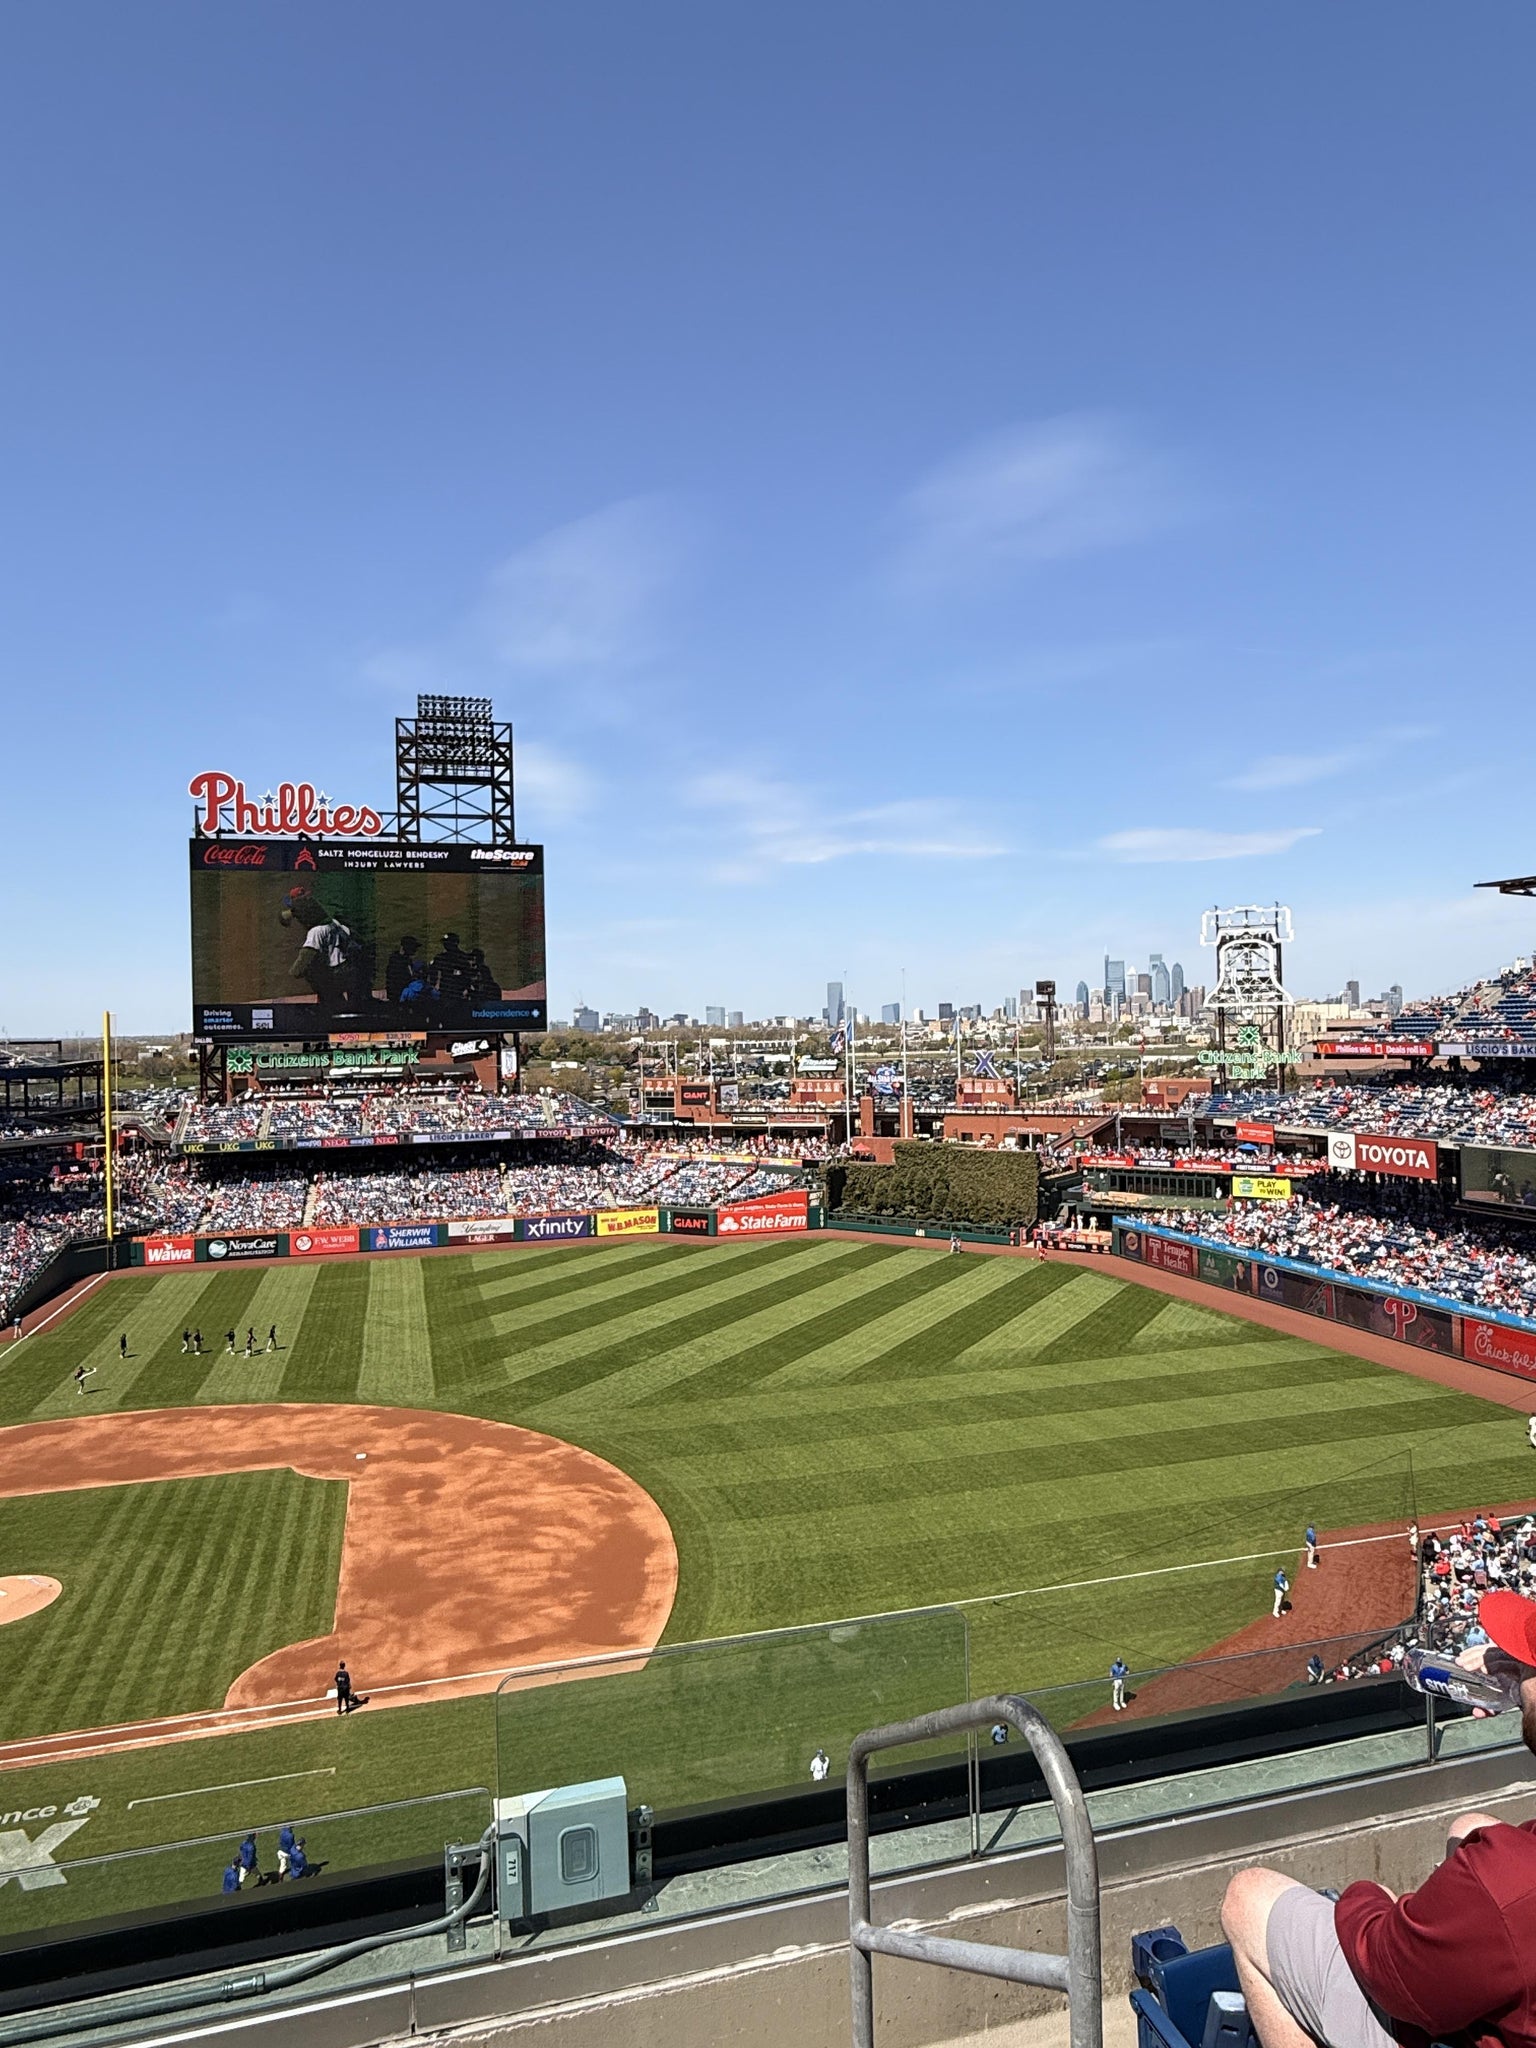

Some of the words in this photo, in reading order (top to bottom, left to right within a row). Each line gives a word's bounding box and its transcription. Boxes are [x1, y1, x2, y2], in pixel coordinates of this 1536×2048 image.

[188, 770, 383, 836] Phillies
[318, 850, 344, 858] SALTZ
[406, 851, 449, 859] BENDESKY
[470, 849, 534, 861] theScore
[384, 861, 425, 869] LAWYERS
[203, 1009, 232, 1017] Driving
[472, 1009, 529, 1018] Independence
[1335, 1044, 1359, 1053] Phillies
[1386, 1045, 1406, 1054] Deals
[1466, 1045, 1508, 1055] LISCIO'S
[1511, 1045, 1536, 1055] BAK
[256, 1051, 330, 1068] Citizens
[332, 1048, 379, 1066] Bank
[380, 1047, 420, 1065] Park
[1198, 1049, 1259, 1063] Citizens
[1262, 1049, 1303, 1063] Bank
[1232, 1065, 1267, 1079] Park
[538, 1129, 568, 1137] TOYOTA
[585, 1127, 616, 1135] TOYOTA
[429, 1133, 463, 1142] LISCIO'S
[464, 1132, 495, 1141] BAKERY
[183, 1144, 204, 1153] UKG
[220, 1142, 240, 1151] UKG
[254, 1140, 275, 1149] UKG
[1358, 1143, 1430, 1169] TOYOTA
[1257, 1180, 1277, 1188] PLAY
[1266, 1188, 1286, 1196] WIN!
[528, 1217, 584, 1237] xfinity
[674, 1217, 708, 1229] GIANT
[389, 1227, 430, 1238] SHERWIN
[331, 1235, 355, 1243] WEBB
[468, 1234, 495, 1243] LAGER
[228, 1239, 277, 1251] NovaCare
[1162, 1241, 1190, 1260] Temple
[148, 1248, 193, 1262] Wawa
[1163, 1256, 1188, 1271] Health
[1384, 1297, 1418, 1340] P
[1425, 1678, 1469, 1697] smart
[0, 1805, 58, 1824] nce
[508, 1859, 517, 1877] 717
